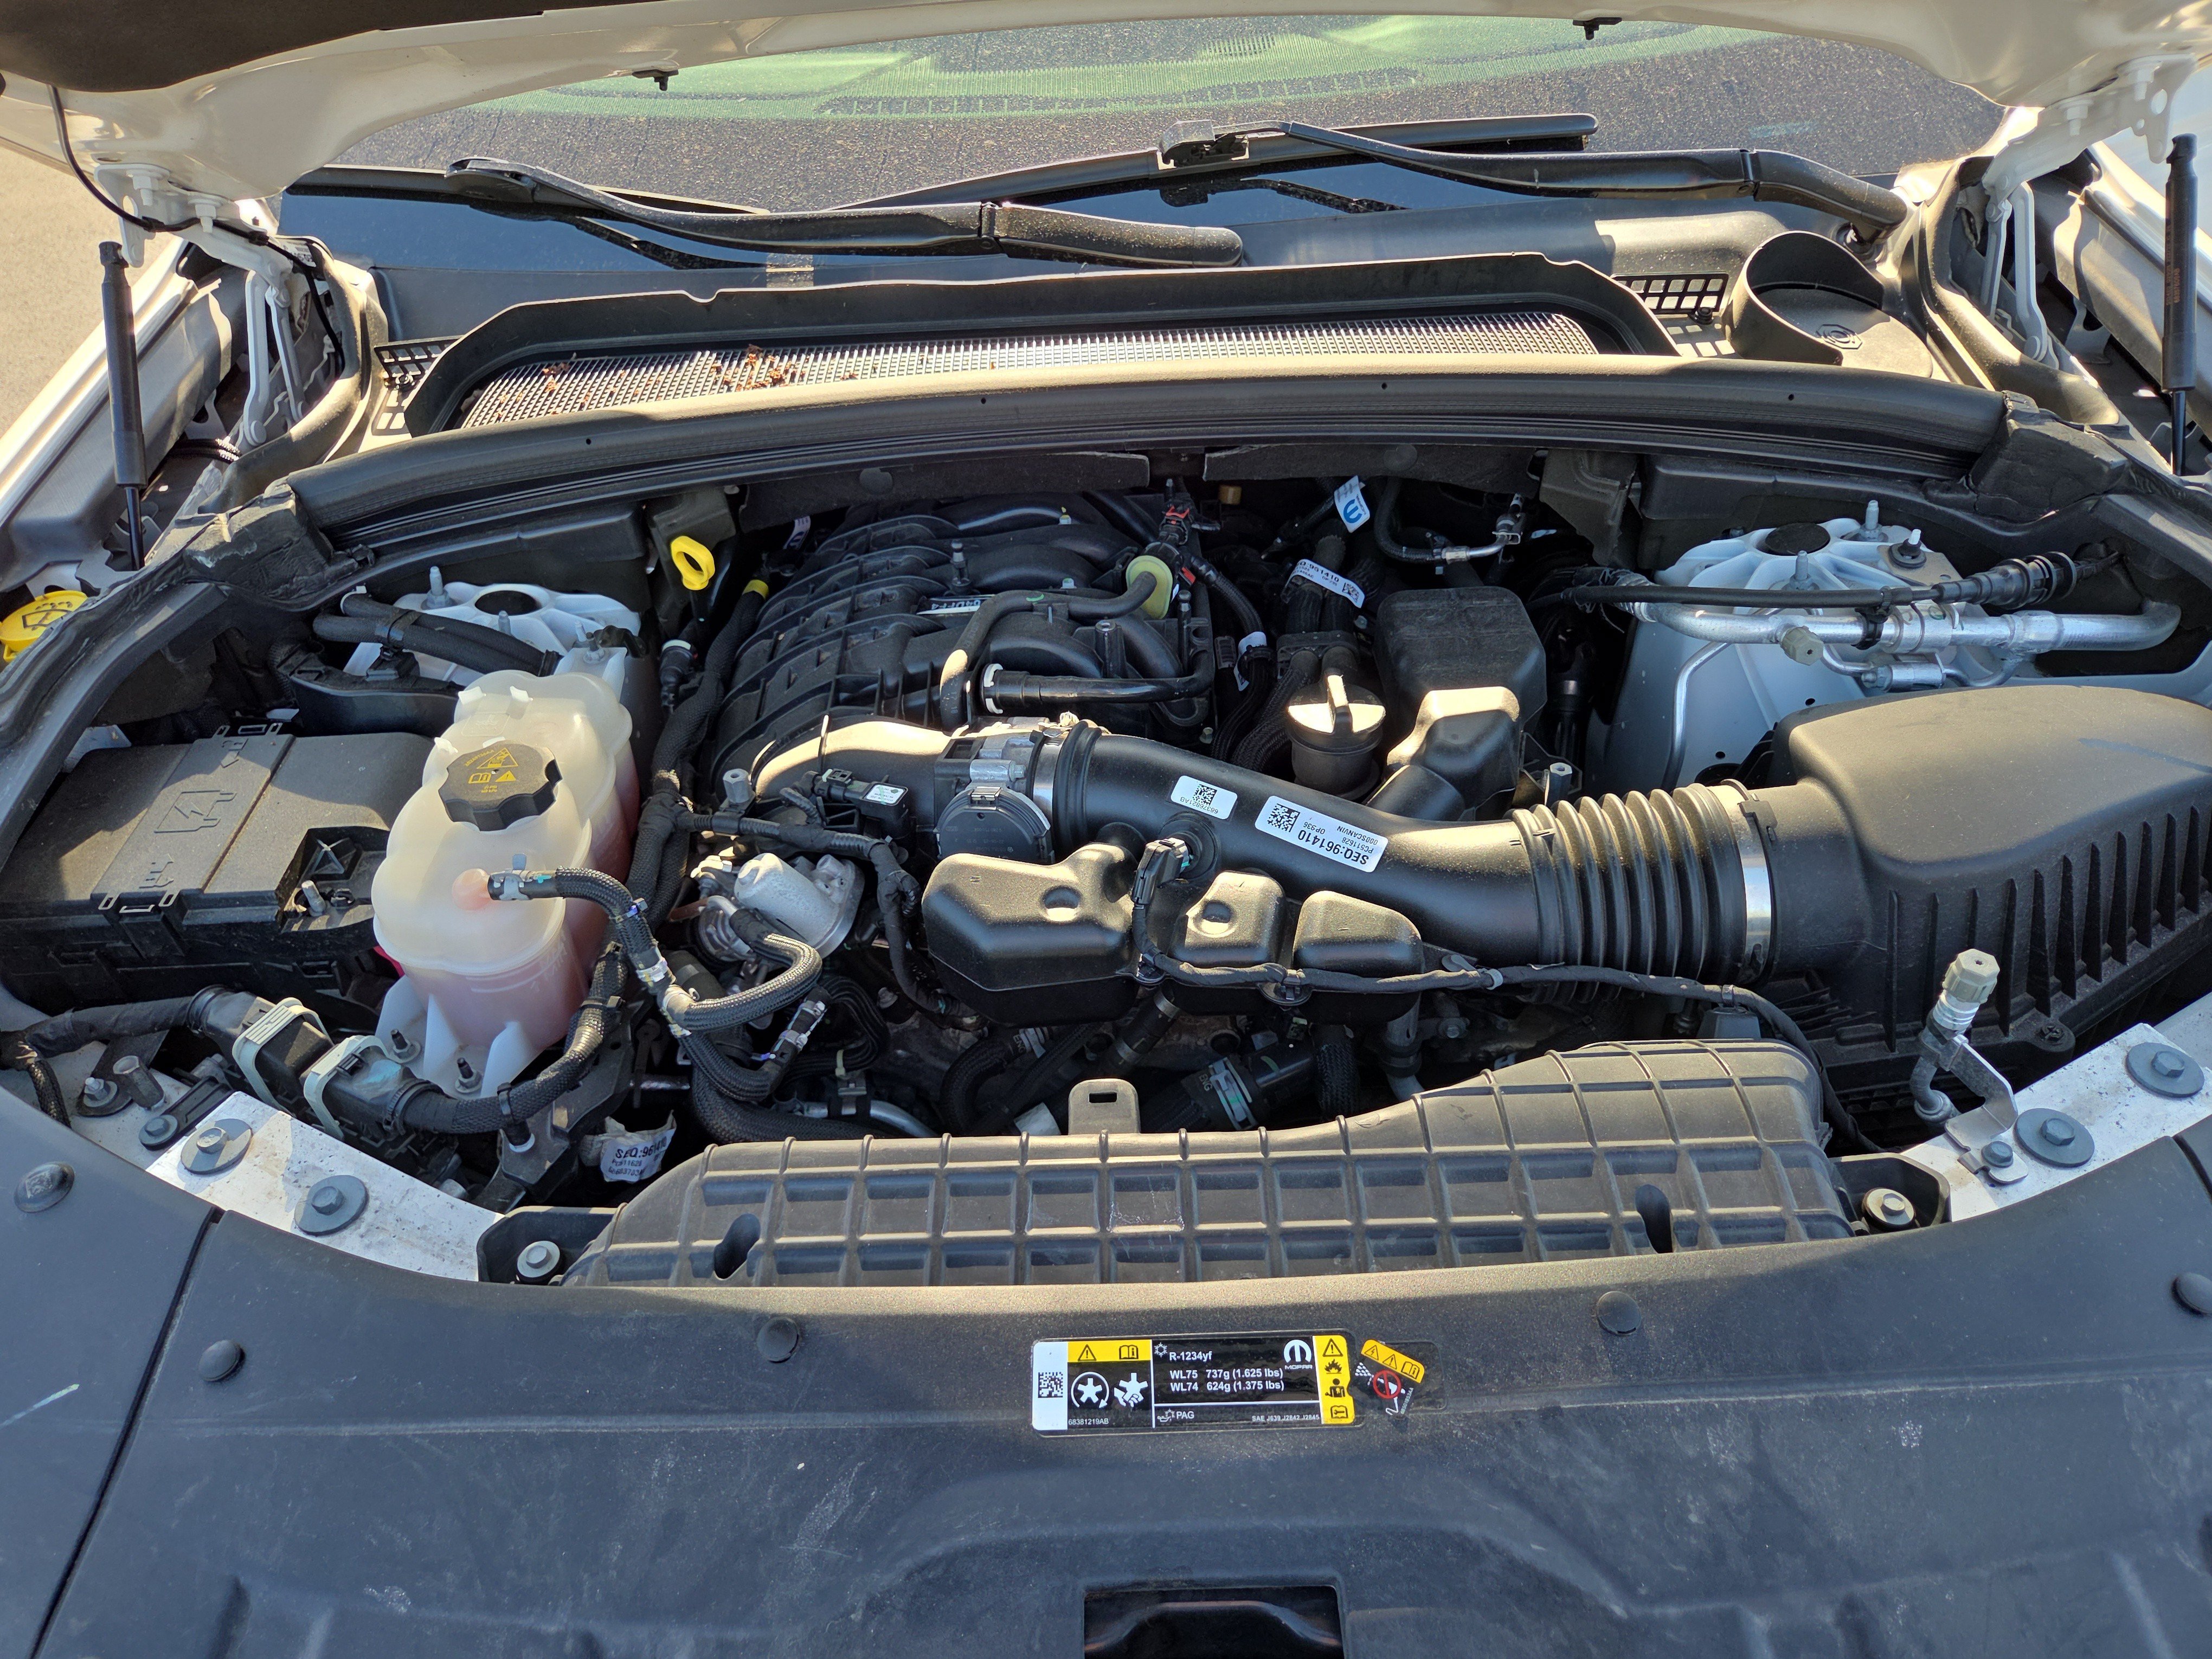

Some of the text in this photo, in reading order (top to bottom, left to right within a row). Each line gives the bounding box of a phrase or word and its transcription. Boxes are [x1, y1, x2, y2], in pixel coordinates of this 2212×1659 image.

[1180, 796, 1218, 814] 68376821AB
[1298, 829, 1369, 864] SEQ:961410
[1341, 837, 1374, 853] PC511628
[1169, 1351, 1212, 1362] R-1234yf
[1170, 1368, 1283, 1380] WL75 737g (1.625 lbs)
[1170, 1380, 1284, 1392] WL74 624g (1.375 lbs)
[1176, 1411, 1195, 1419] PAG
